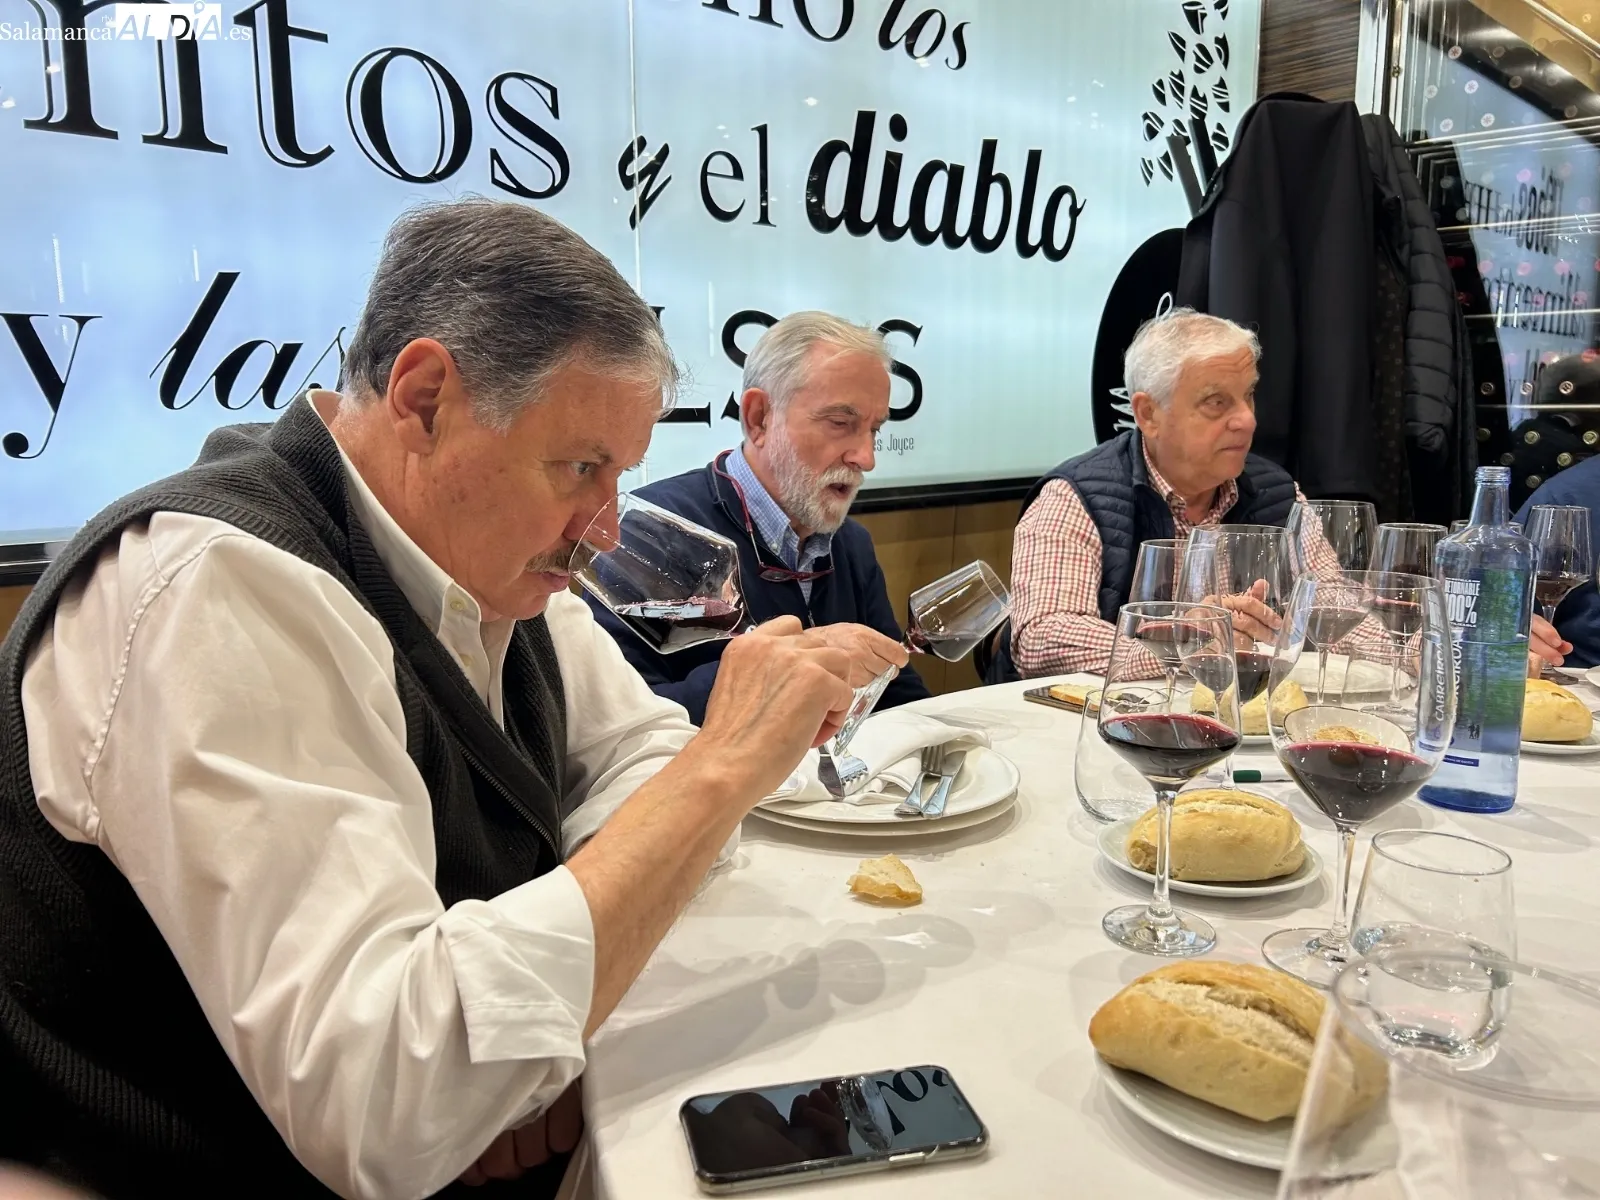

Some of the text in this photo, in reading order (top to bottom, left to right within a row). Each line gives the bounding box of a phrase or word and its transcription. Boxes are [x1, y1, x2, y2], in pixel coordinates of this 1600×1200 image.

[700, 122, 777, 228] el
[805, 109, 1087, 263] diablo
[0, 312, 103, 460] y
[886, 433, 914, 456] Joyce
